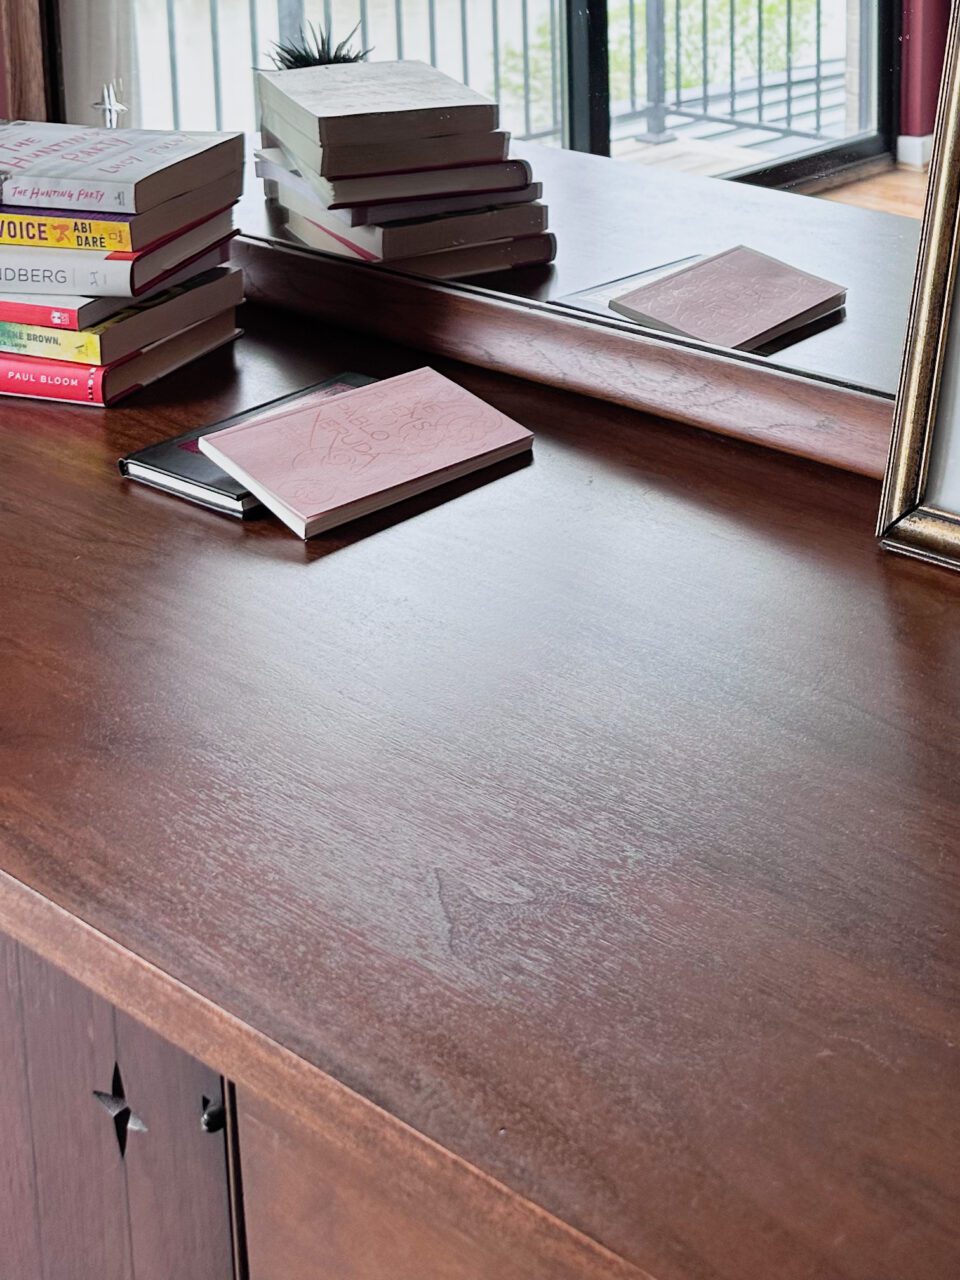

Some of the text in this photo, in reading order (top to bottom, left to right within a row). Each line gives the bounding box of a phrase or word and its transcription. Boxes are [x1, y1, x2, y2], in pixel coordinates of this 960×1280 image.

[0, 136, 41, 152] THE
[61, 137, 132, 163] PARTY
[98, 155, 144, 174] LUCY
[11, 186, 105, 203] THE HUNTING PARTY
[73, 221, 92, 233] ABI
[76, 234, 106, 248] DARÉ
[0, 267, 67, 283] DBERG
[8, 371, 78, 386] PAUL BLOOM
